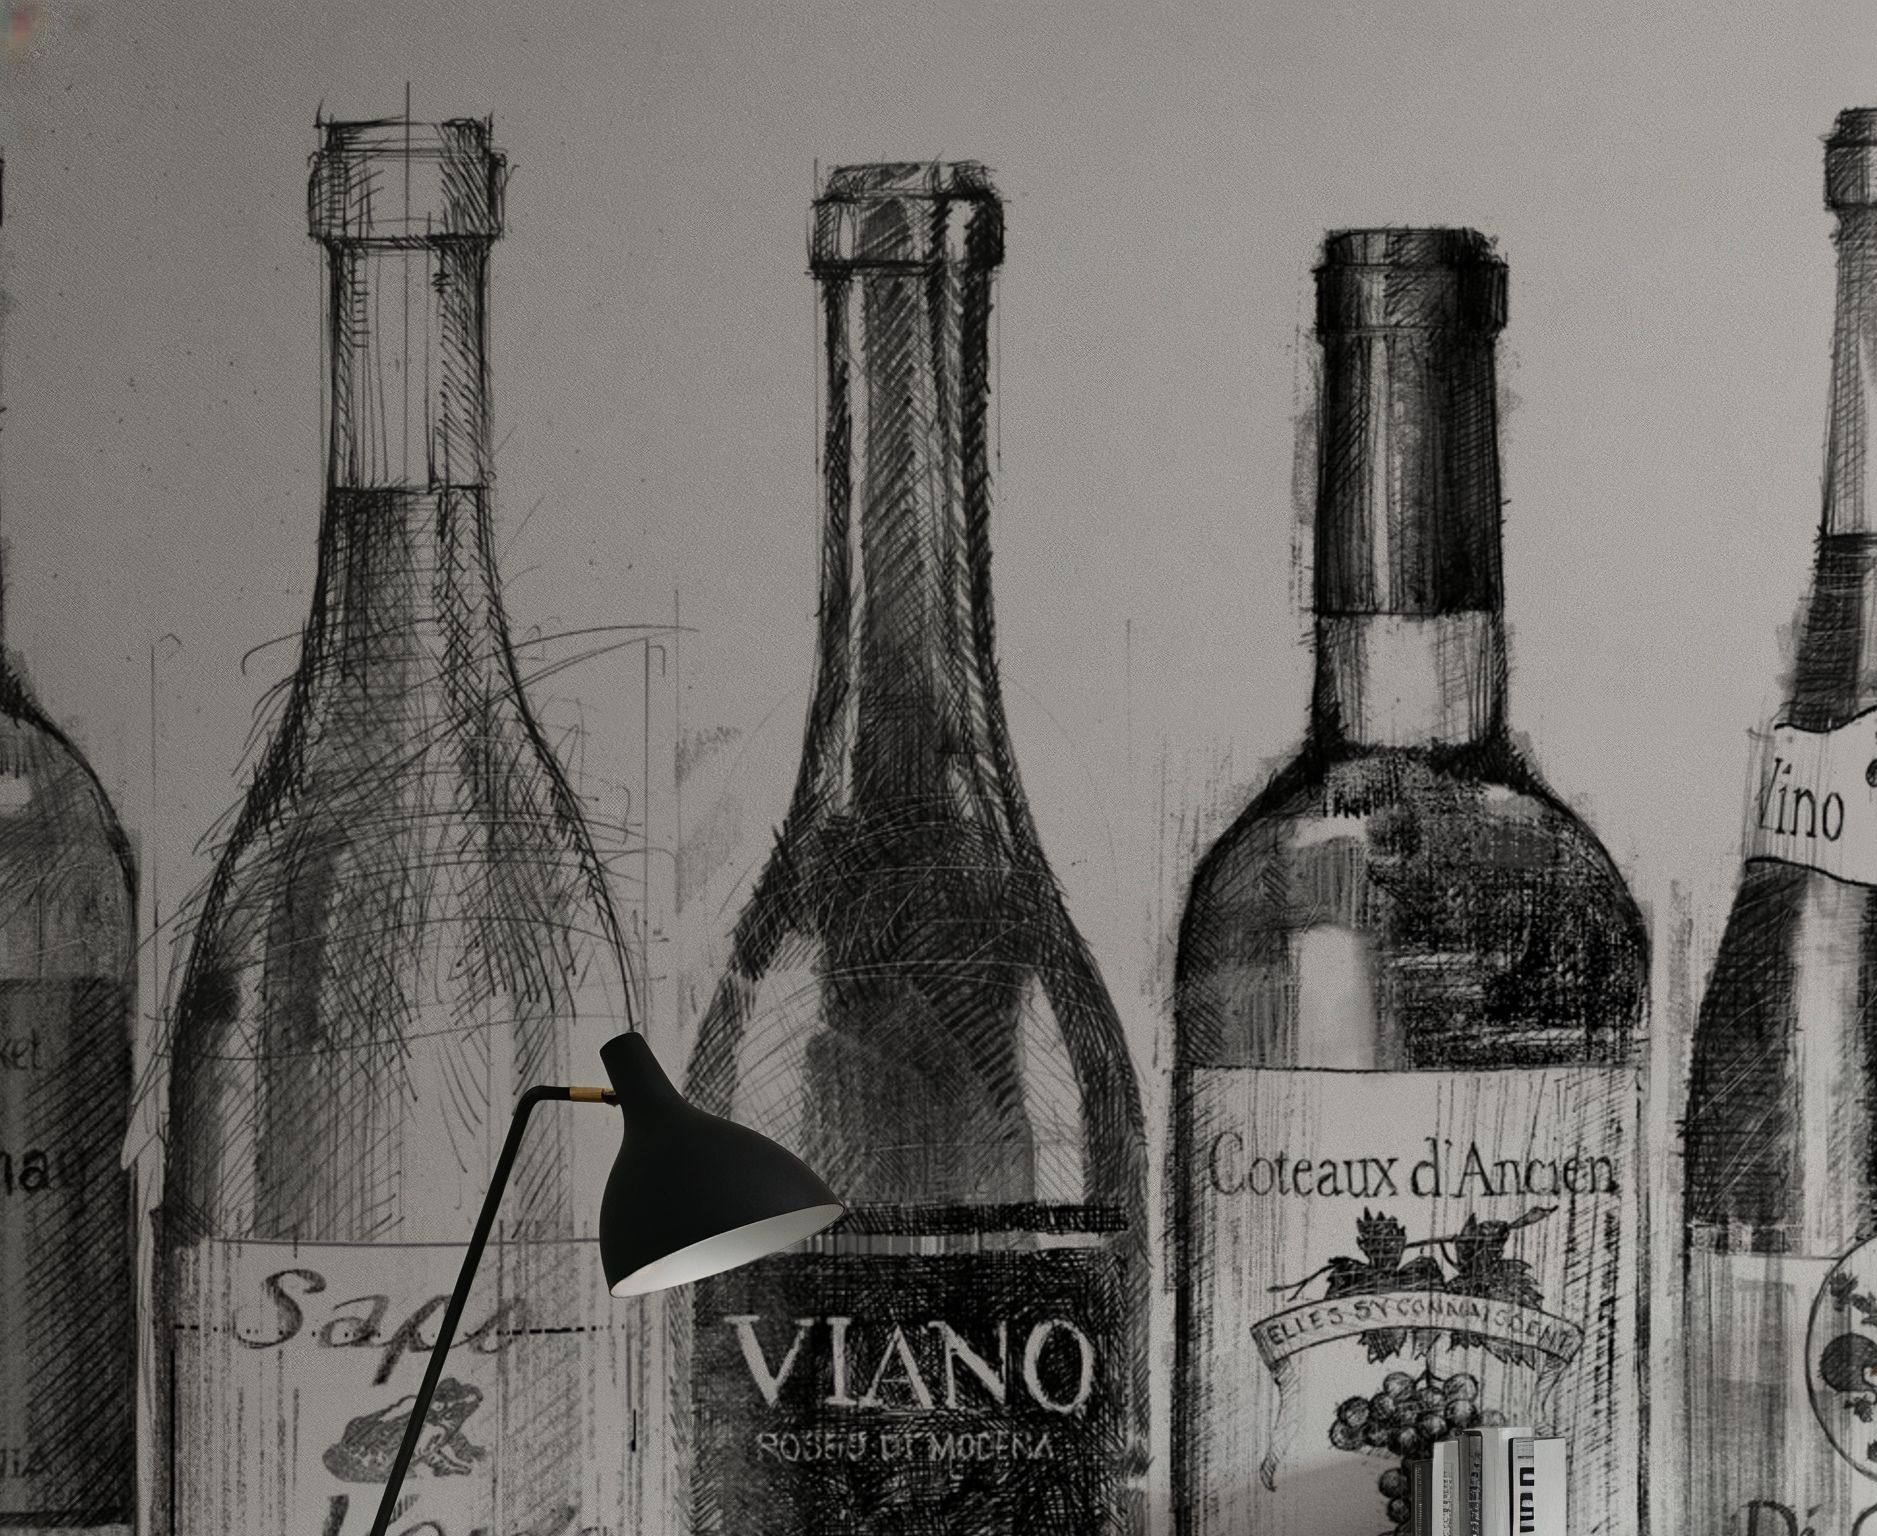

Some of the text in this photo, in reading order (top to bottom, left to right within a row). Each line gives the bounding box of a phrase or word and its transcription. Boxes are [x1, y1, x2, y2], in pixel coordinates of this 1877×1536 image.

[1208, 1131, 1619, 1199] Coteaux d'Ancien
[724, 1314, 1097, 1415] VIANO
